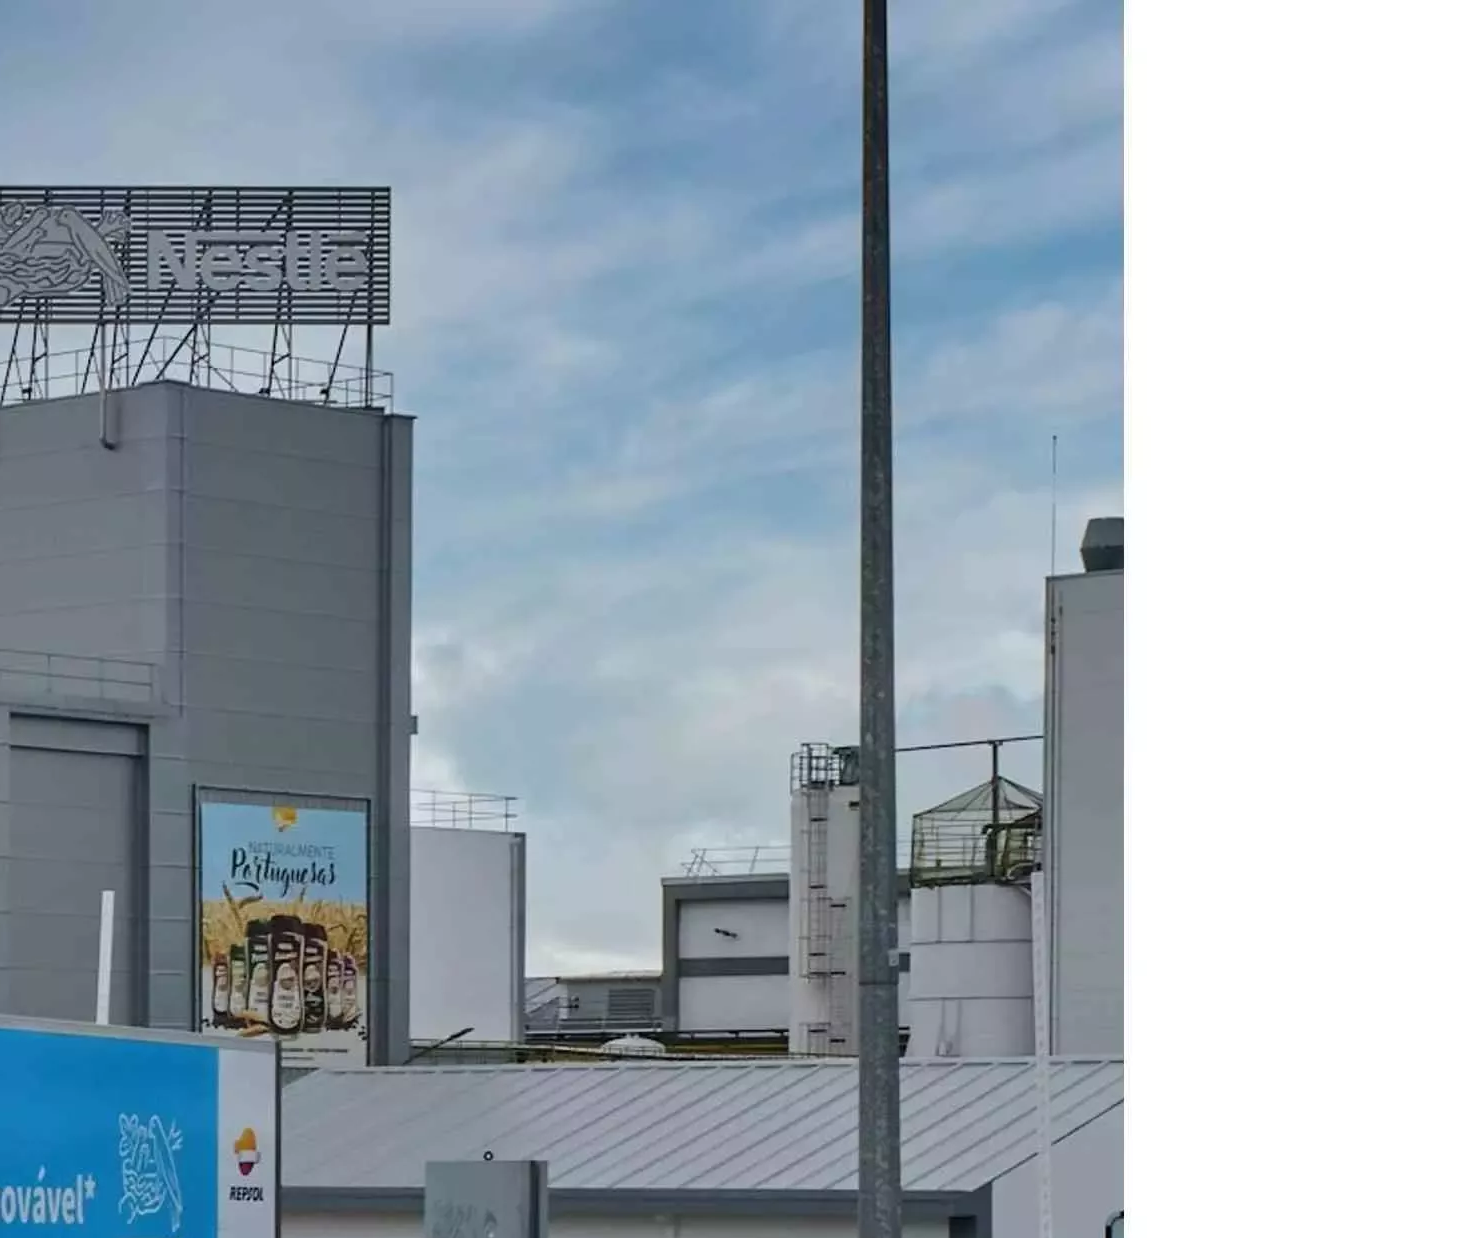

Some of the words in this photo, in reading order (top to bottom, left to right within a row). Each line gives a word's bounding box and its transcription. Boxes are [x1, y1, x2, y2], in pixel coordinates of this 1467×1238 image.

[147, 229, 369, 292] Nestlé
[248, 840, 337, 860] NATURALMENTE
[231, 847, 337, 898] Portuguesas
[229, 1186, 264, 1202] REPSOL
